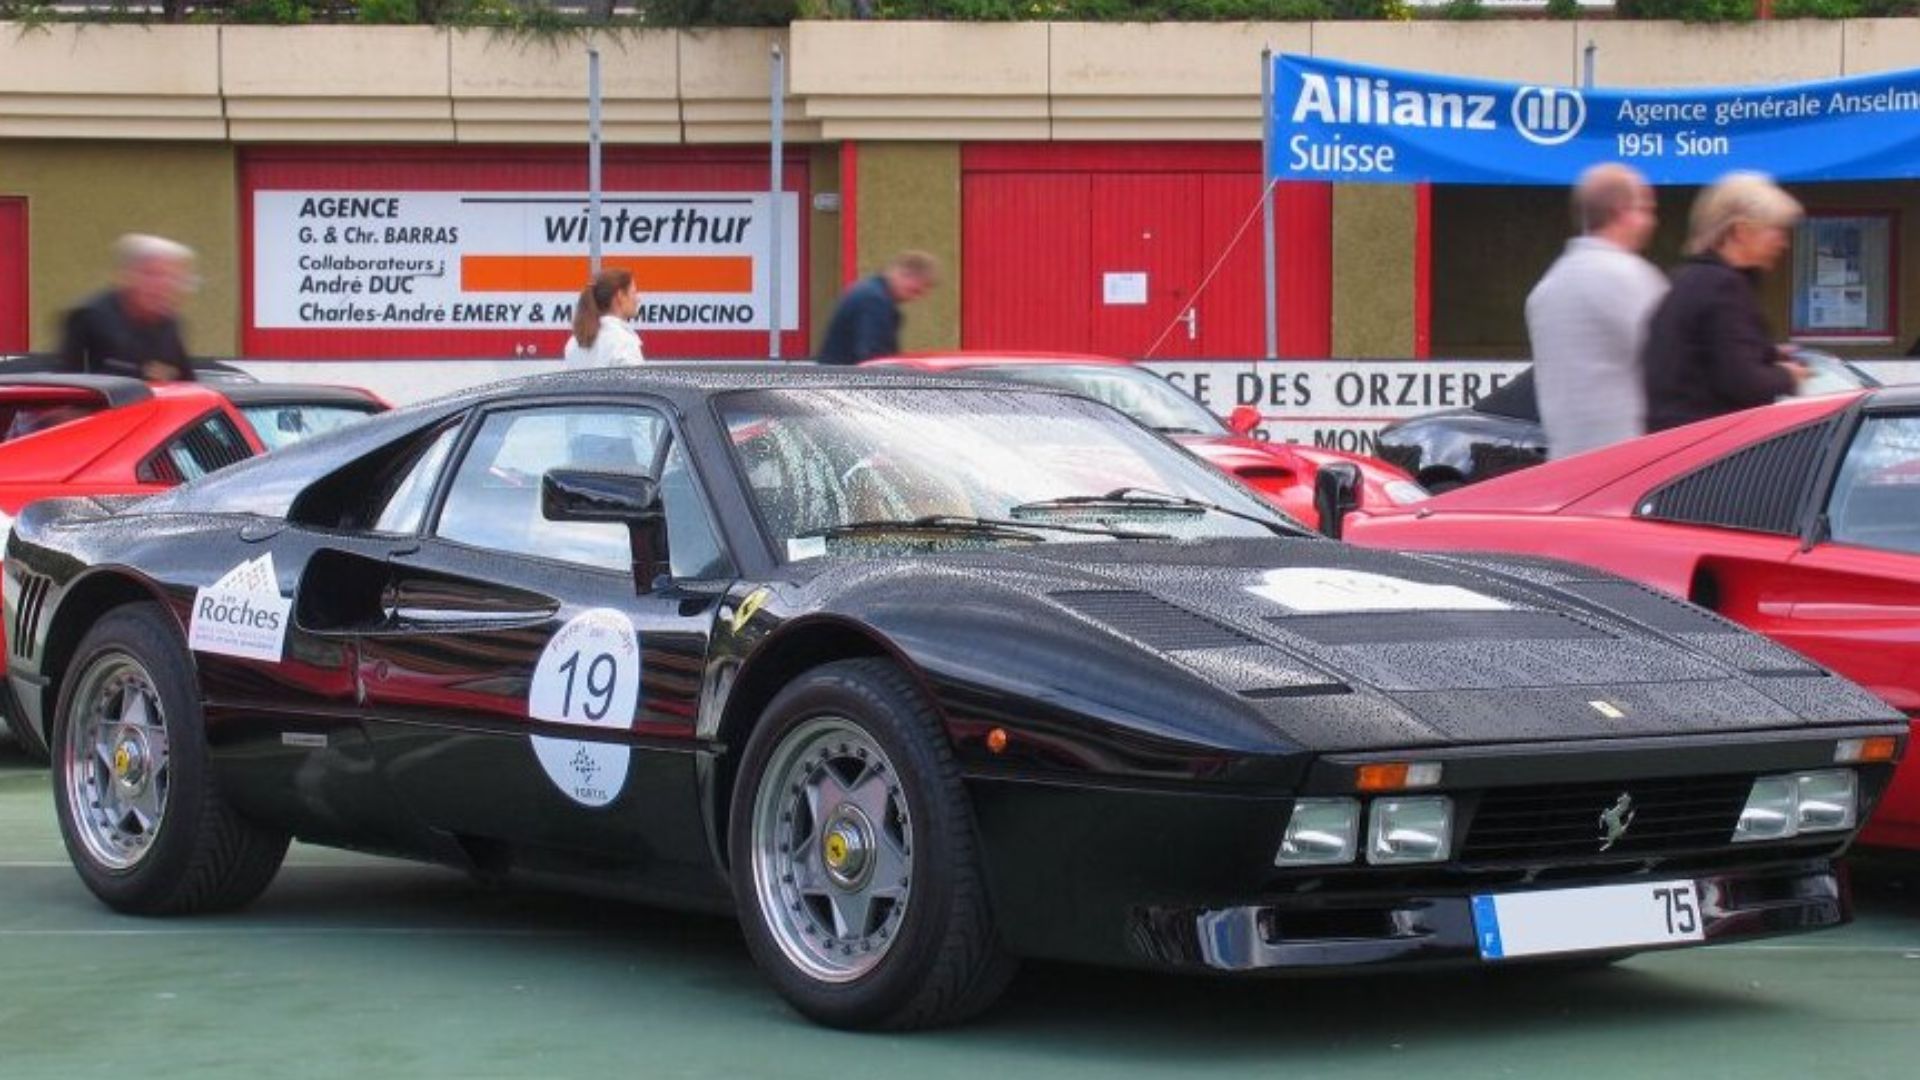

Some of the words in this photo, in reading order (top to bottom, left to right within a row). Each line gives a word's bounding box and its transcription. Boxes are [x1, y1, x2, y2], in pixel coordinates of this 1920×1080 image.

[1291, 72, 1496, 130] Allianz
[1617, 99, 1707, 125] Agence
[1715, 94, 1820, 125] générale
[1828, 87, 1920, 114] Anselm
[1289, 132, 1394, 172] Suisse
[1616, 133, 1662, 157] 1951
[1675, 131, 1729, 156] Sion
[300, 197, 399, 218] AGENCE
[299, 226, 317, 244] G.
[323, 226, 337, 244] &
[344, 227, 379, 244] Chr.
[384, 226, 458, 244] BARRAS
[545, 208, 752, 243] winterthur
[299, 255, 434, 271] Collaborateurs
[300, 275, 363, 294] André
[369, 275, 414, 294] DUC
[299, 302, 446, 322] Charles-André
[452, 303, 524, 322] EMERY
[529, 302, 544, 322] &
[1236, 372, 1311, 406] DES
[199, 596, 281, 631] Roches
[559, 650, 617, 720] 19
[1652, 888, 1696, 934] 75
